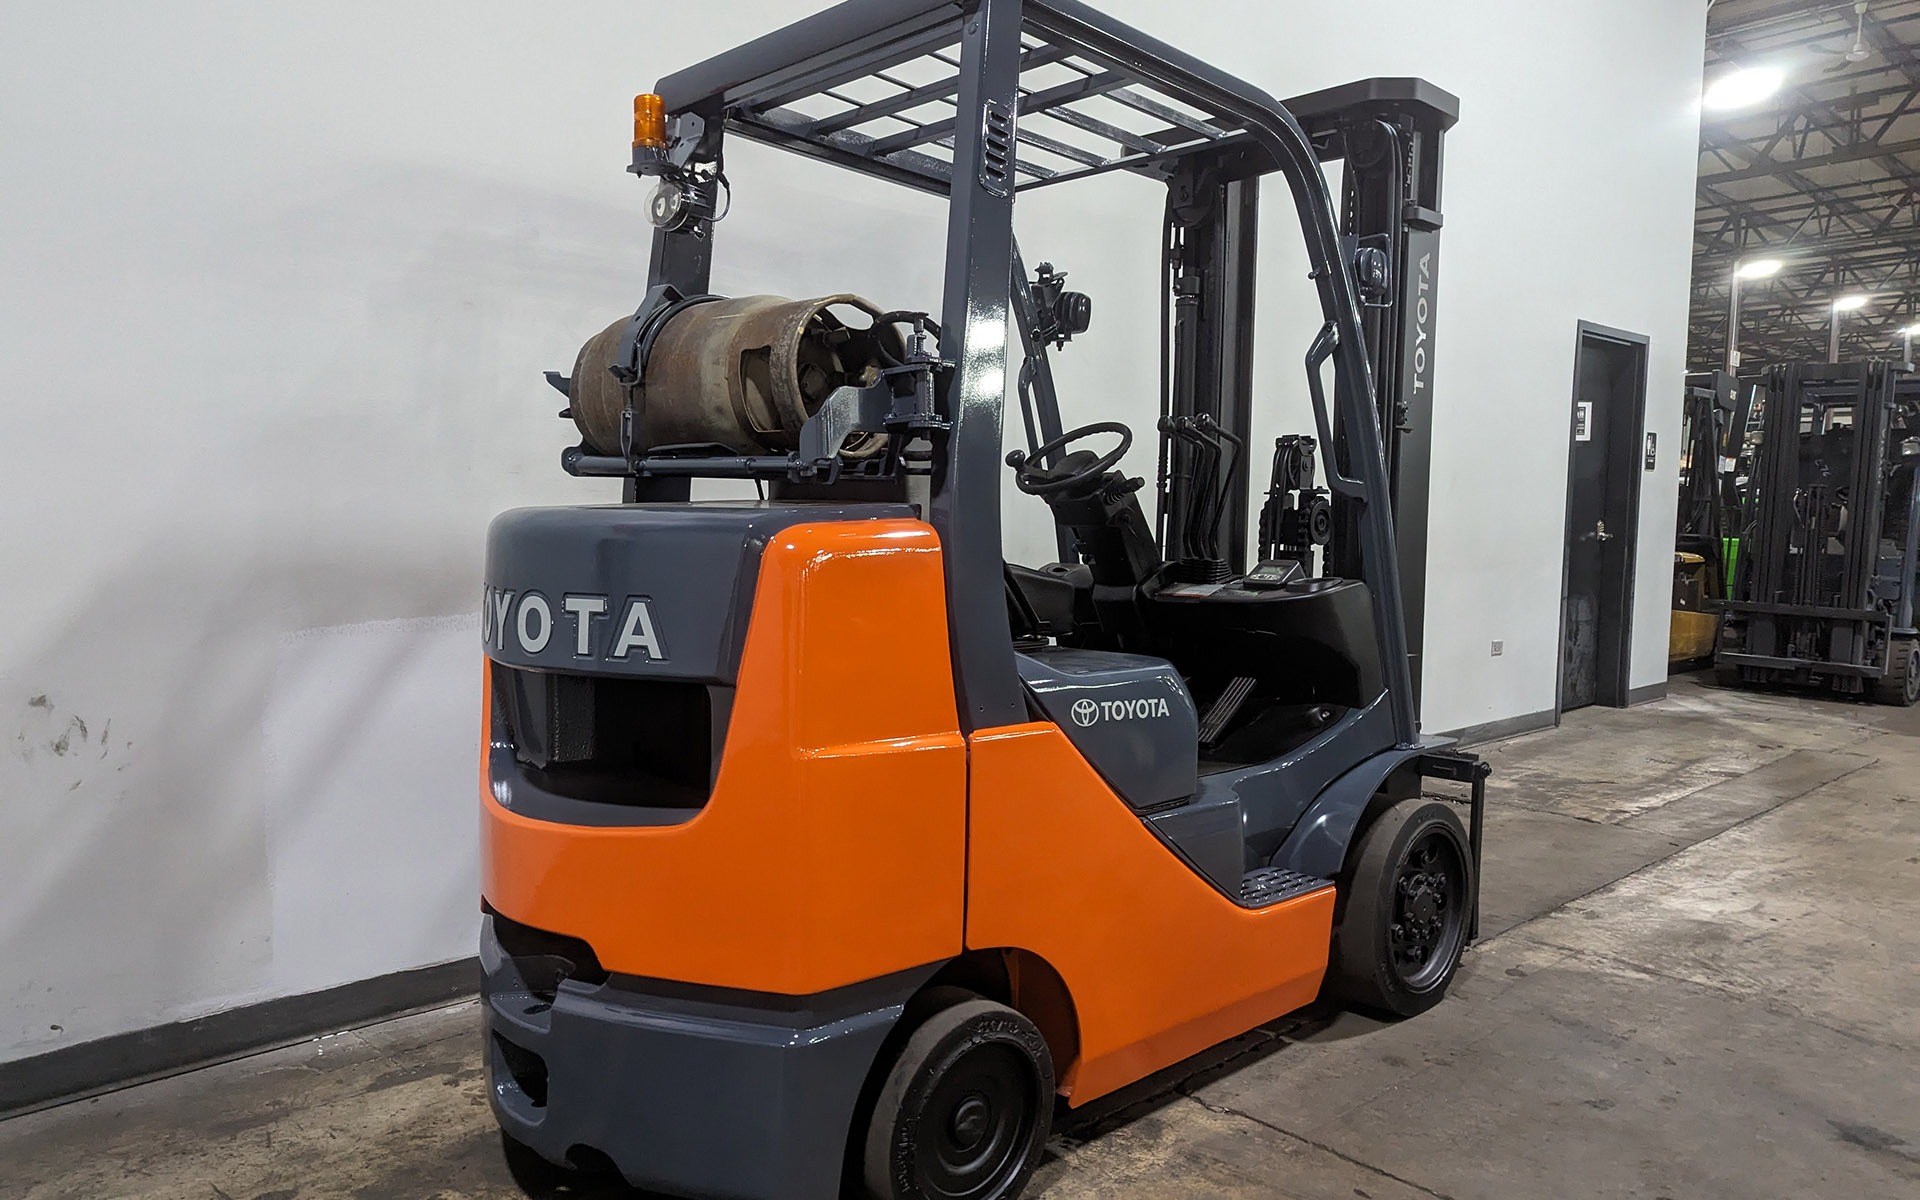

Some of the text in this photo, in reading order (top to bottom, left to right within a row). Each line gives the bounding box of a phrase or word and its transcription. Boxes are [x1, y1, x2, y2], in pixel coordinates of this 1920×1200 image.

[1413, 252, 1430, 395] TOYOTA
[483, 588, 664, 659] OYOTA
[1100, 698, 1171, 721] TOYOTA
